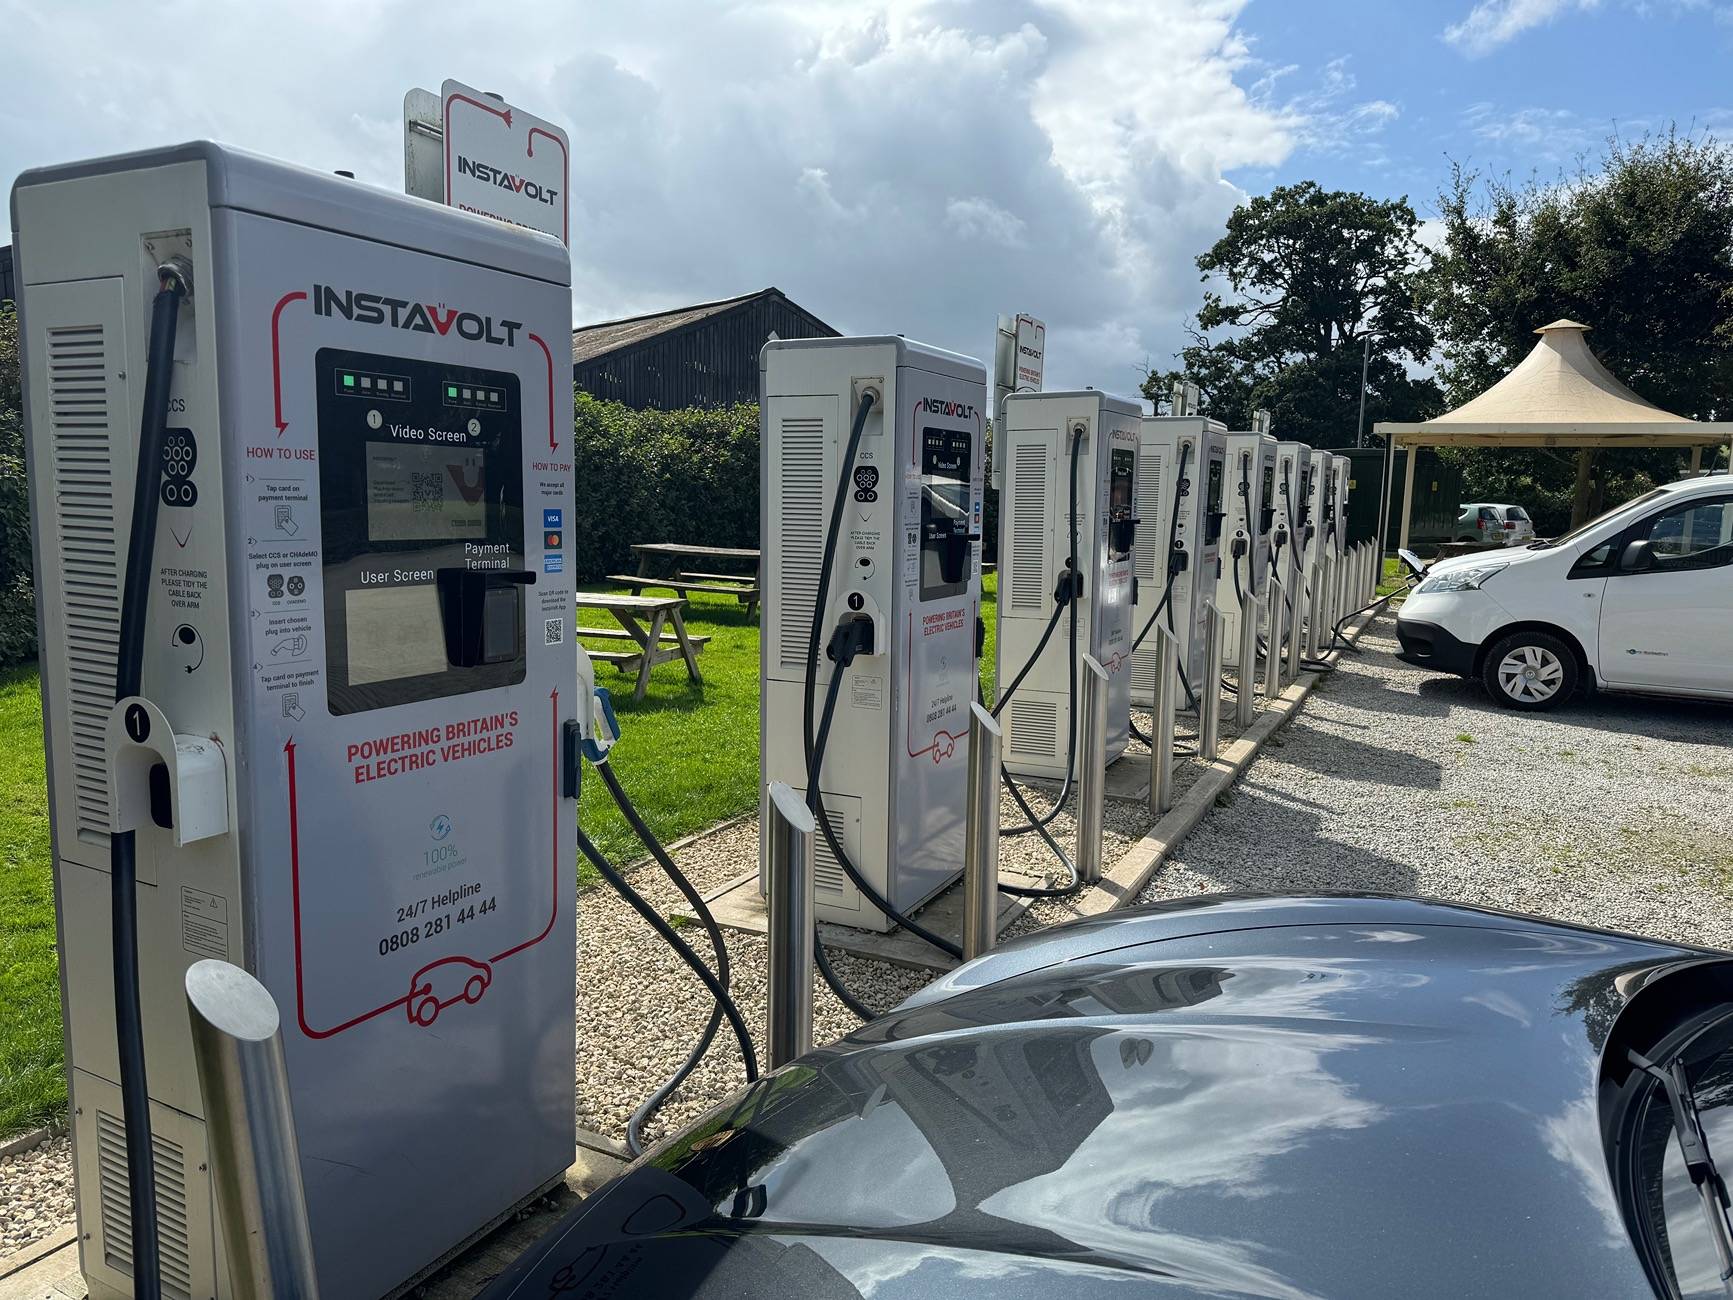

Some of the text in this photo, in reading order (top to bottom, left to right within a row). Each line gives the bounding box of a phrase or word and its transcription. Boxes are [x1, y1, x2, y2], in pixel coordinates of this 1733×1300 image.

[458, 155, 558, 206] INSTAVOLT
[313, 284, 522, 347] INSTAVOLT
[923, 397, 973, 419] INSTAVOLT
[390, 424, 466, 442] Video Screen
[471, 422, 477, 432] 2
[247, 447, 315, 460] HOW TO USE
[533, 462, 571, 472] HOW TO PAY
[465, 543, 509, 556] Payment
[256, 561, 269, 570] plug
[465, 557, 510, 570] Terminal
[161, 568, 207, 578] AFTER CHARGING
[361, 569, 434, 584] User Screen
[161, 579, 207, 589] PLEASE TIDY THE
[168, 589, 202, 599] CABLE BACK
[171, 600, 200, 609] OVER ARM
[853, 595, 858, 608] 1
[923, 613, 945, 625] POWERING
[265, 628, 278, 636] plug
[924, 619, 964, 636] ELECTRIC VEHICLES
[295, 670, 319, 679] payment
[267, 683, 291, 691] terminal
[133, 711, 141, 736] 1
[347, 711, 519, 763] POWERING BRITAIN'S
[355, 732, 513, 784] ELECTRIC VEHICLES
[424, 844, 457, 865] 100%
[413, 857, 467, 880] renewable power
[396, 882, 481, 923] 24/7 Helpline
[379, 896, 497, 956] 0808 281 44 44
